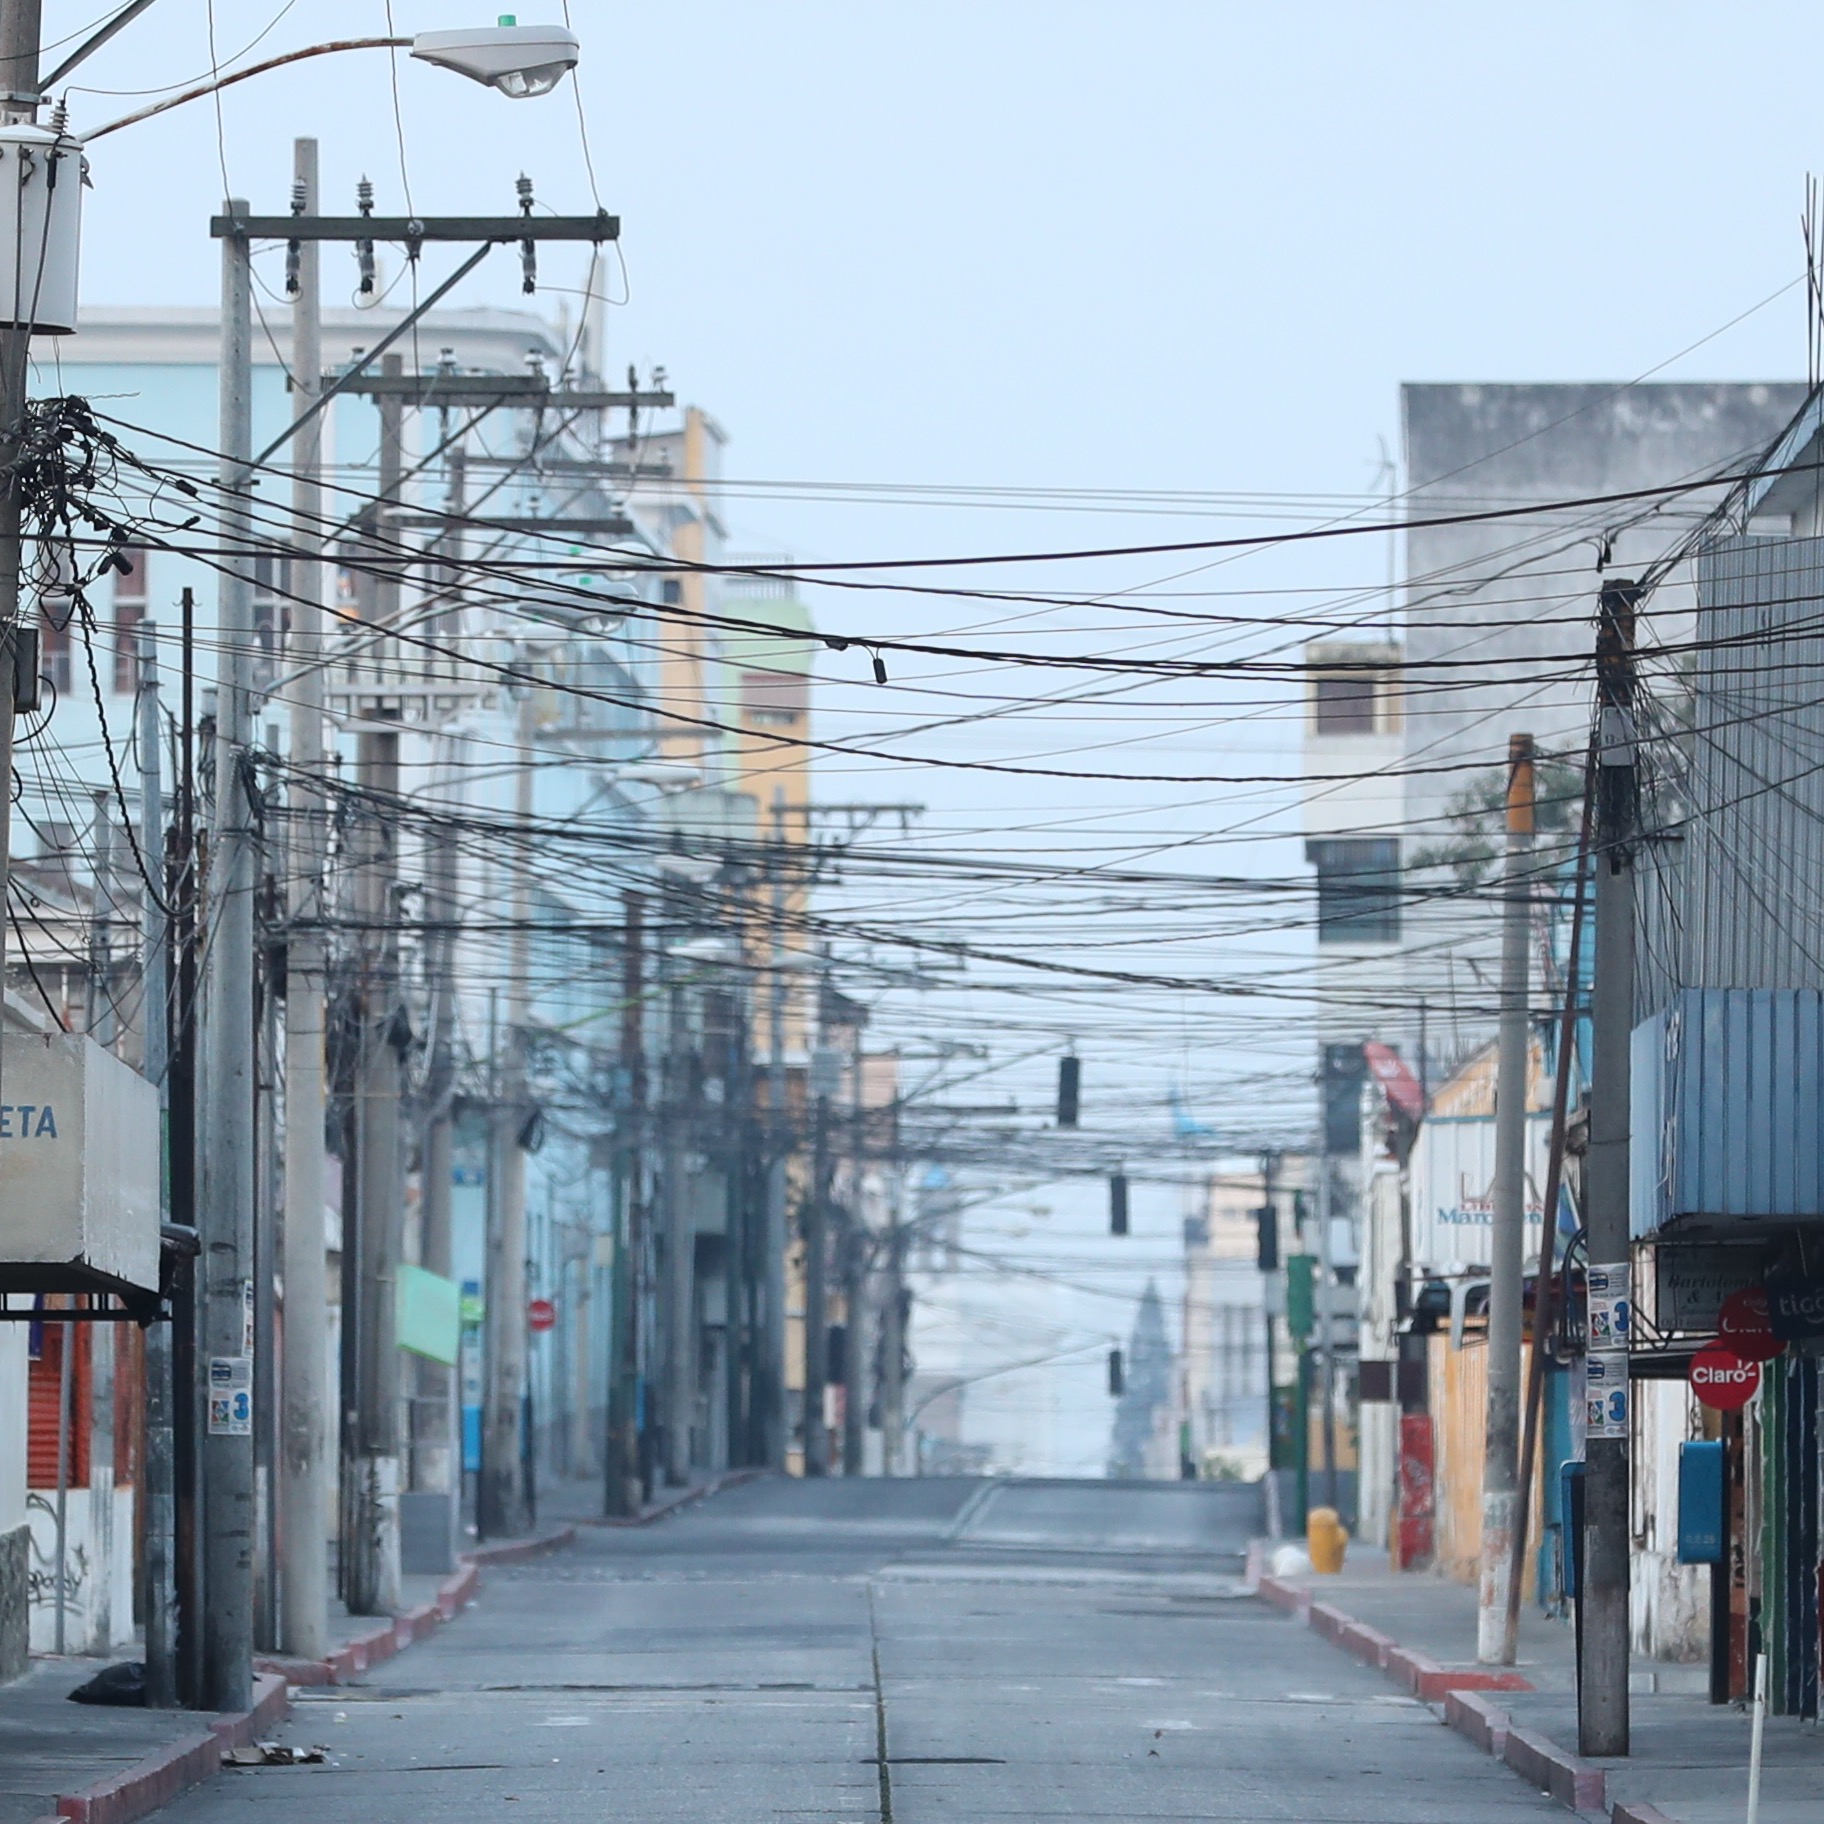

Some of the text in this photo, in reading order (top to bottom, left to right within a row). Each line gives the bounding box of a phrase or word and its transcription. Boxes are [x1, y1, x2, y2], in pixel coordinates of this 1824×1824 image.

[1614, 1301, 1629, 1332] 3
[1692, 1364, 1750, 1384] Claro
[233, 1393, 249, 1420] 3
[1609, 1391, 1626, 1422] 3
